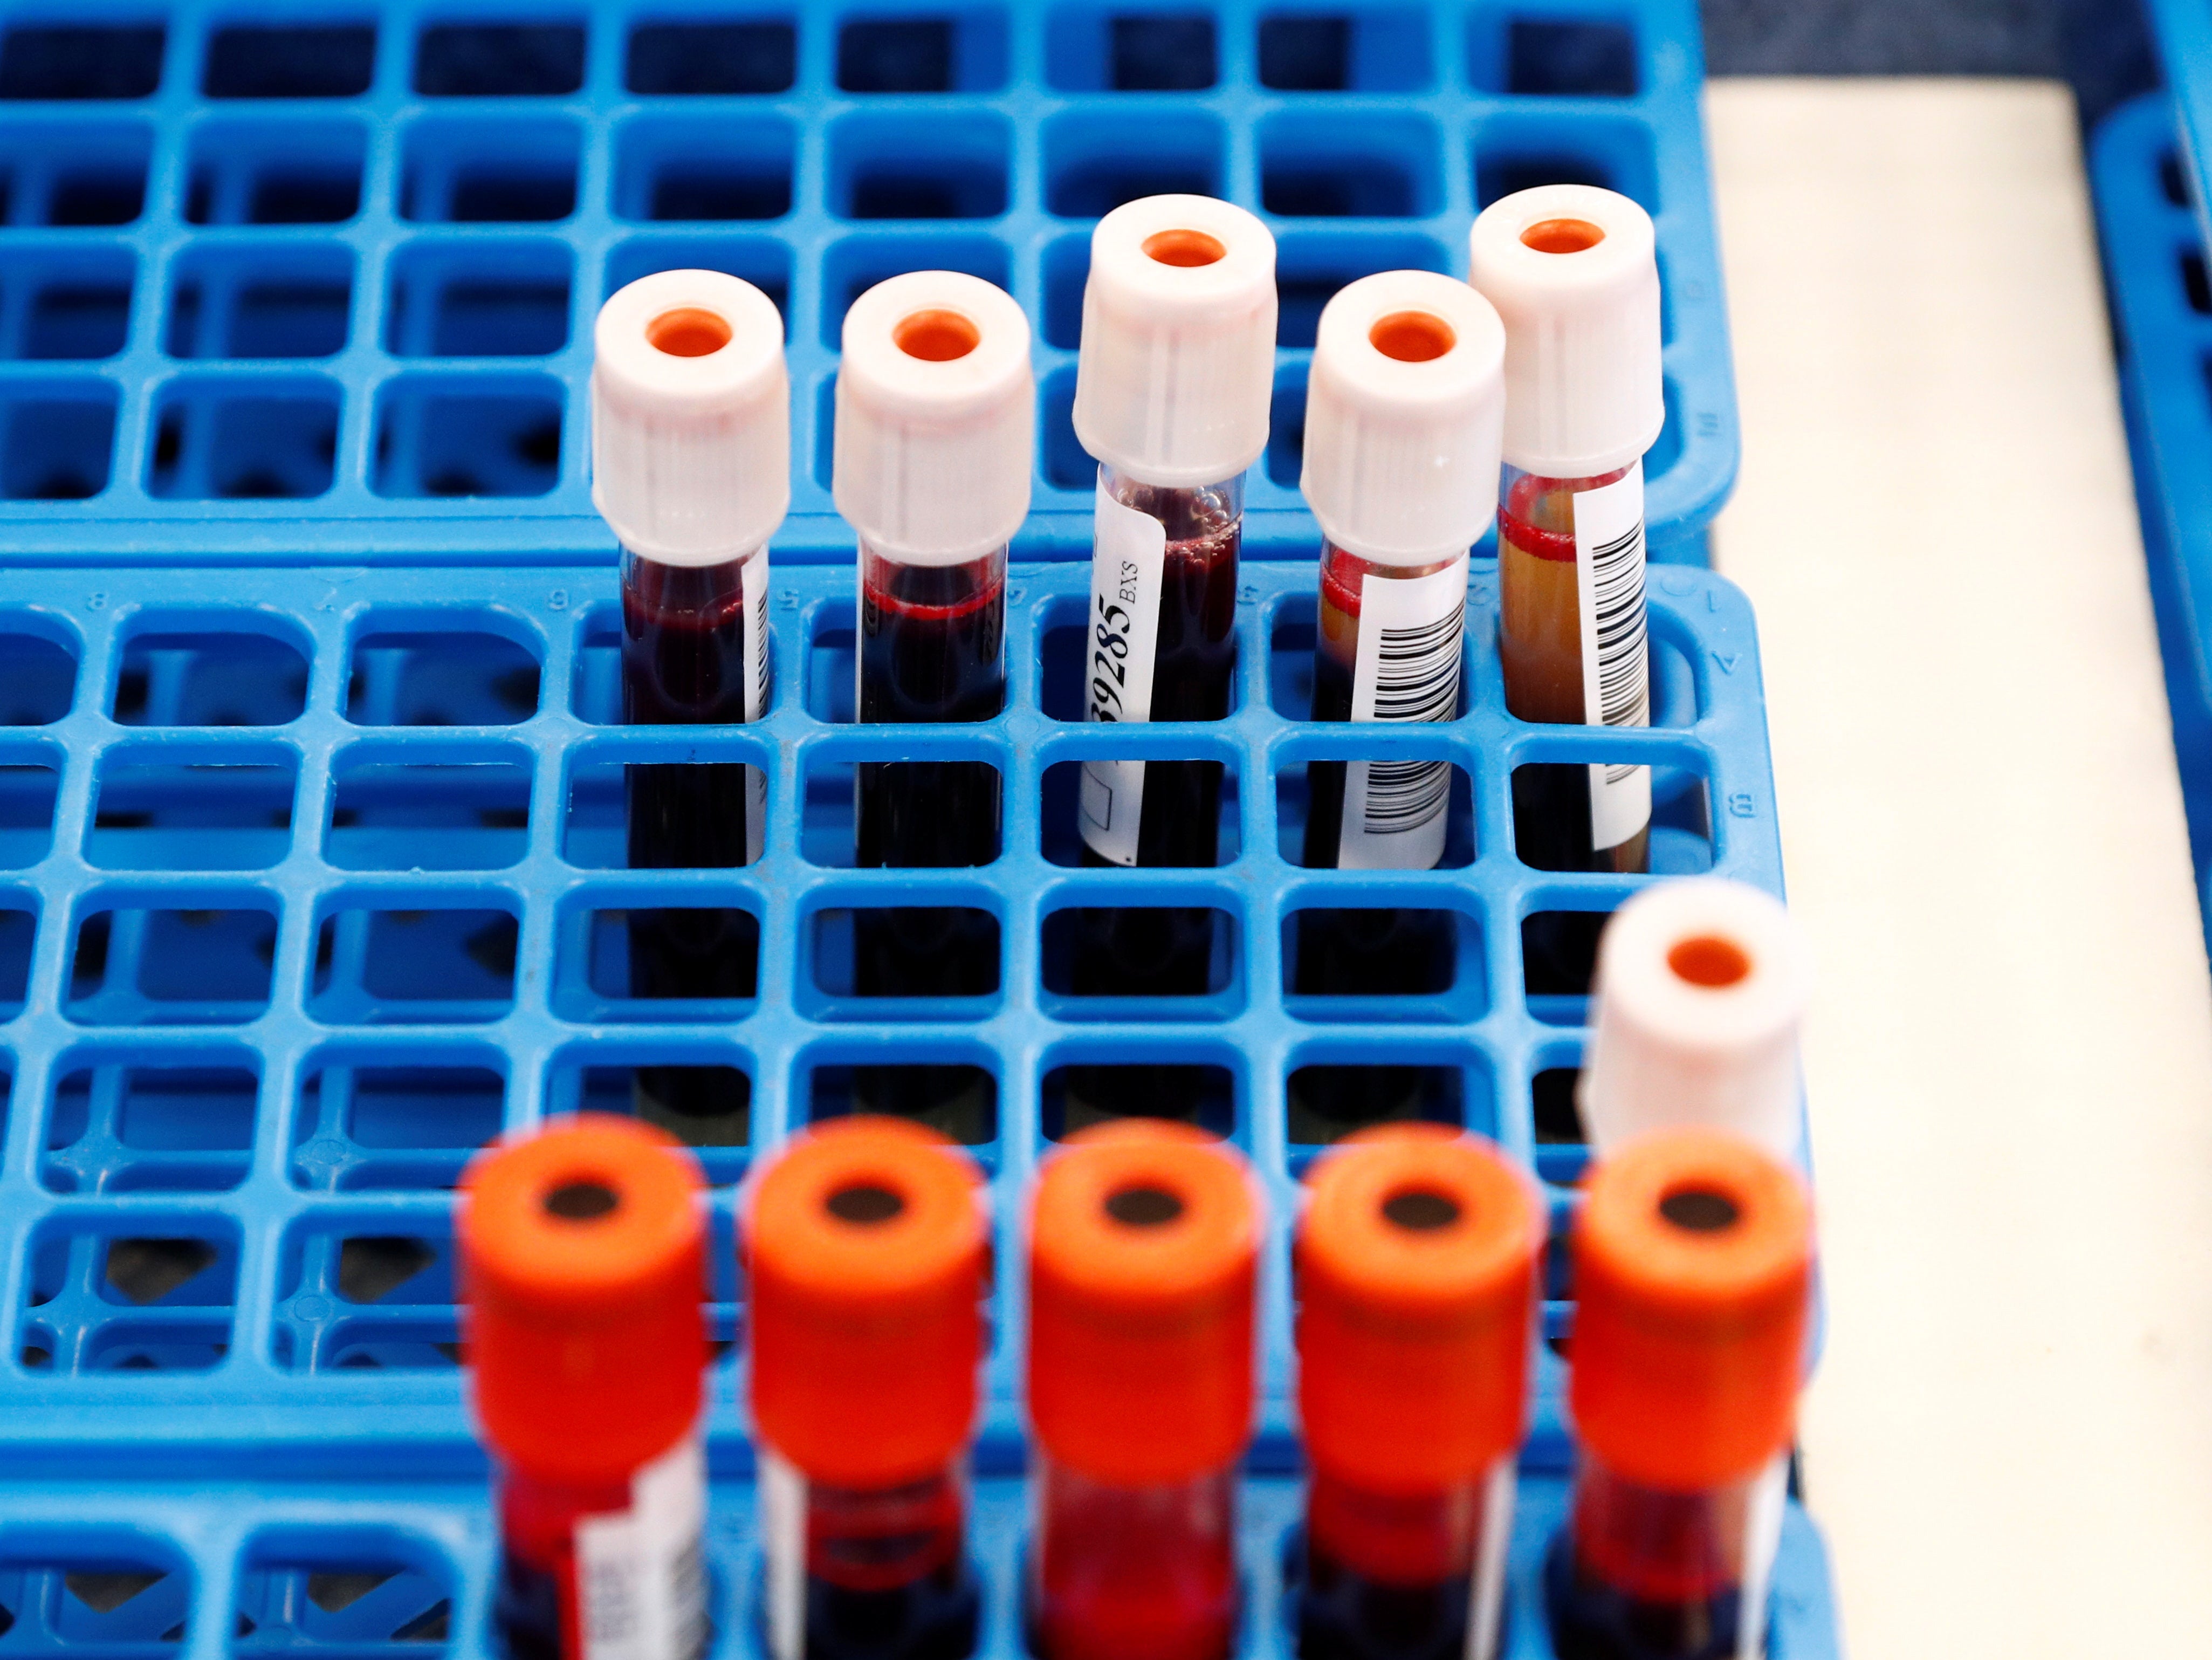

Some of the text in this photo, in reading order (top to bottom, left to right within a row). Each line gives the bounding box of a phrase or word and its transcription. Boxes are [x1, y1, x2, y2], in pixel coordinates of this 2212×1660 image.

[1120, 560, 1138, 604] BXS
[85, 591, 107, 611] 8
[778, 589, 799, 611] 5
[1712, 650, 1742, 675] A
